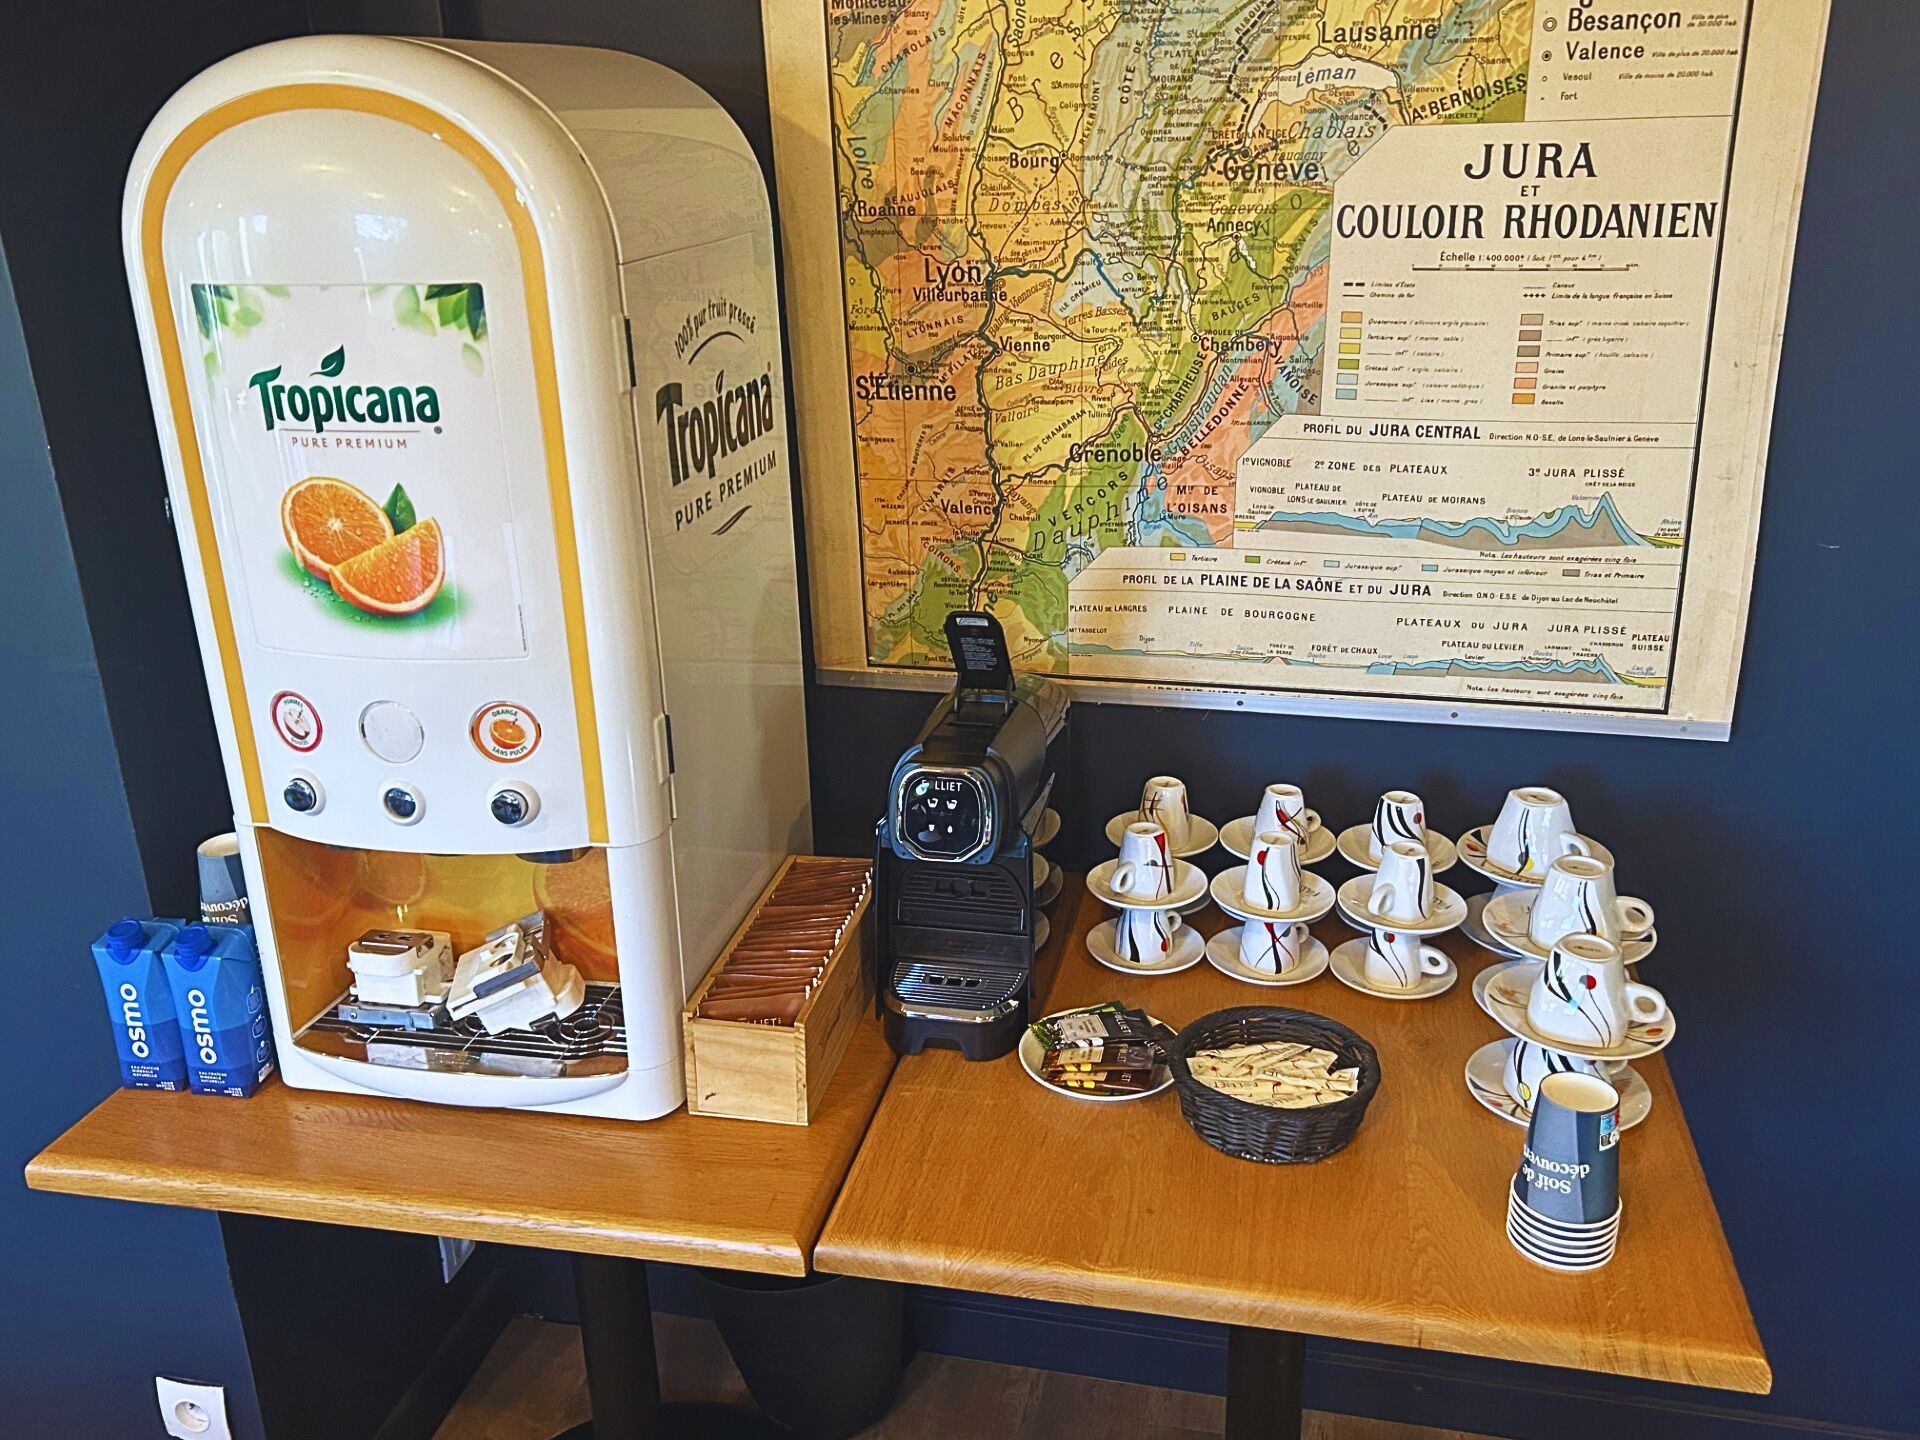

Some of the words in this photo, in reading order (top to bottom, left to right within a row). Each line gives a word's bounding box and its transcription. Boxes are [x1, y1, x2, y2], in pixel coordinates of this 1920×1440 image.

[1567, 7, 1682, 34] Besançon
[1320, 21, 1438, 44] Lausanne
[881, 27, 946, 73] CHAROLAIS
[1565, 41, 1645, 61] Valence
[1295, 67, 1357, 88] Léman
[1562, 71, 1592, 81] Vesoul
[944, 52, 987, 127] MÂCONNAIS
[1428, 72, 1529, 117] BERNOISES
[1560, 91, 1578, 101] Fort
[1079, 80, 1100, 146] REVERMONT
[1288, 121, 1377, 140] Chablais
[846, 135, 875, 190] Loire
[1009, 152, 1060, 174] Bourg
[1464, 142, 1598, 179] JURA
[884, 178, 954, 206] BEAUJOLAIS
[1520, 185, 1541, 197] ET
[858, 200, 916, 218] Roanne
[989, 197, 1061, 213] Dombes
[1207, 217, 1260, 238] Annecy
[1336, 204, 1484, 239] COULOIR
[1502, 202, 1719, 240] RHODANIEN
[1440, 251, 1476, 262] Échelle
[924, 257, 982, 290] Lyon
[1211, 293, 1260, 321] BAUGES
[675, 314, 694, 360] 100%
[693, 309, 706, 337] pur
[707, 296, 728, 321] fruit
[728, 302, 756, 334] pressé
[907, 315, 965, 338] LYONNAIS
[999, 336, 1051, 352] Vienne
[995, 372, 1023, 391] Bas
[1162, 352, 1207, 418] CHARTREUSE
[1274, 354, 1319, 406] VANOISE
[249, 364, 441, 434] Tropicana
[994, 405, 1040, 424] Valloire
[1180, 383, 1250, 457] BELLEDONNE
[656, 370, 774, 488] Tropicana
[1303, 423, 1342, 435] PROFIL
[1346, 425, 1362, 436] DU
[1369, 424, 1410, 437] JURA
[1415, 425, 1481, 440] CENTRAL
[1489, 432, 1523, 441] Direction
[292, 437, 328, 448] PURE
[336, 437, 408, 450] PREMIUM
[1069, 442, 1162, 464] Grenoble
[1250, 457, 1292, 468] VIGNOBLE
[1327, 461, 1356, 471] ZONE
[1362, 464, 1382, 472] DES
[1389, 464, 1448, 475] PLATEAUX
[1543, 468, 1576, 477] JURA
[1583, 467, 1626, 478] PLISSÉ
[675, 490, 713, 531] PURE
[718, 449, 778, 503] PREMIUM
[920, 466, 956, 513] VIVARAIS
[1250, 486, 1286, 494] VIGNOBLE
[1295, 482, 1330, 492] PLATEAU
[940, 499, 1000, 516] Valenc
[1048, 472, 1128, 527] VERCORS
[1382, 493, 1423, 503] PLATEAU
[1428, 496, 1438, 504] DE
[1441, 496, 1486, 505] MOIRANS
[923, 541, 962, 574] COIRONS
[1122, 574, 1158, 585] PROFIL
[1163, 575, 1178, 585] DE
[1181, 576, 1194, 586] LA
[1200, 574, 1248, 588] PLAINE
[1252, 576, 1271, 589] DE
[1274, 577, 1291, 590] LA
[1296, 576, 1343, 593] SAÔNE
[1349, 584, 1364, 594] ET
[1367, 585, 1383, 595] DU
[1389, 584, 1432, 597] JURA
[1069, 605, 1104, 613] PLATEAU
[1168, 606, 1209, 615] PLAINE
[1220, 608, 1234, 617] DE
[1244, 609, 1317, 622] BOURGOGNE
[1396, 617, 1462, 629] PLATEAUX
[1471, 622, 1485, 630] DU
[1492, 621, 1529, 632] JURA
[1547, 624, 1580, 634] JURA
[1139, 635, 1156, 643] Dijon
[1441, 640, 1480, 650] PLATEAU
[1493, 643, 1525, 652] LEVIER
[1631, 633, 1670, 643] PLATEAU
[1631, 643, 1665, 652] SUISSE
[1350, 646, 1378, 655] CHAUX
[491, 708, 519, 717] ORANGE
[119, 982, 150, 1059] osmo
[187, 988, 218, 1066] osmo
[1534, 1171, 1573, 1194] Soif
